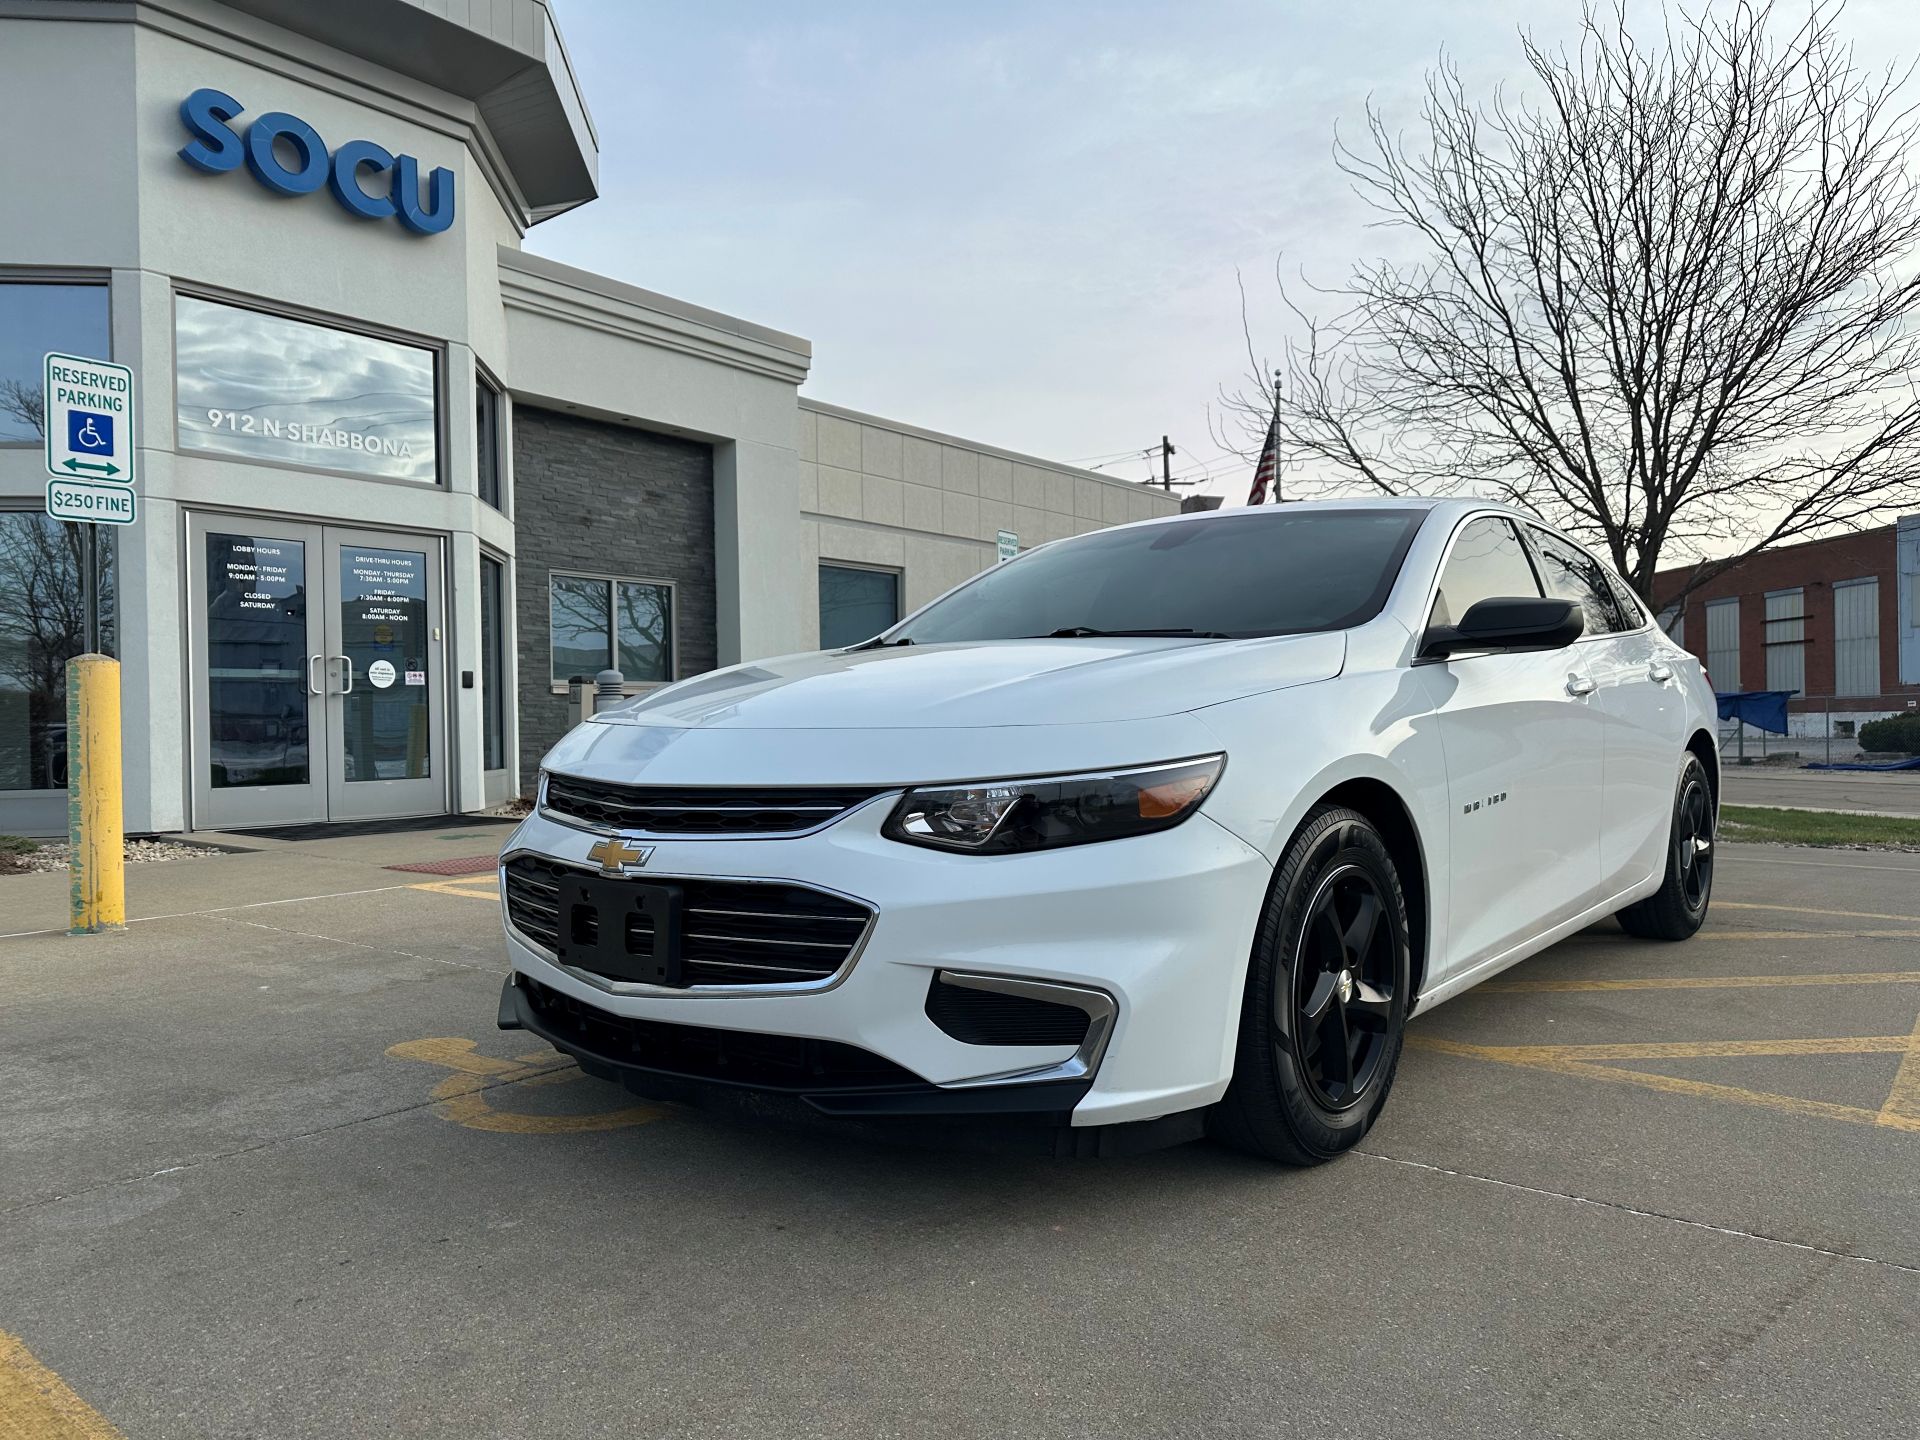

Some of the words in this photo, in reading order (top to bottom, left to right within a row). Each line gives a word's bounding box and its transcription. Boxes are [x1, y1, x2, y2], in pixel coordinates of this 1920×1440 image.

[178, 87, 456, 236] SOCU
[52, 366, 127, 392] RESERVED
[57, 388, 123, 412] PARKING
[207, 408, 256, 433] 912
[262, 418, 281, 438] N
[286, 422, 413, 457] SHABBONA
[54, 490, 93, 508] $250
[96, 496, 130, 512] FINE
[232, 545, 255, 553] LOBBY
[256, 547, 281, 555] HOURS
[226, 563, 258, 571] MONDAY
[262, 565, 287, 573] FRIDAY
[353, 568, 381, 576] MONDAY
[384, 571, 415, 579] THURSDAY
[228, 572, 255, 581] 9:00AM
[260, 575, 286, 583] 5:00PM
[244, 592, 271, 600] CLOSED
[239, 601, 276, 609] SATURDAY
[369, 607, 401, 615] SATURDAY
